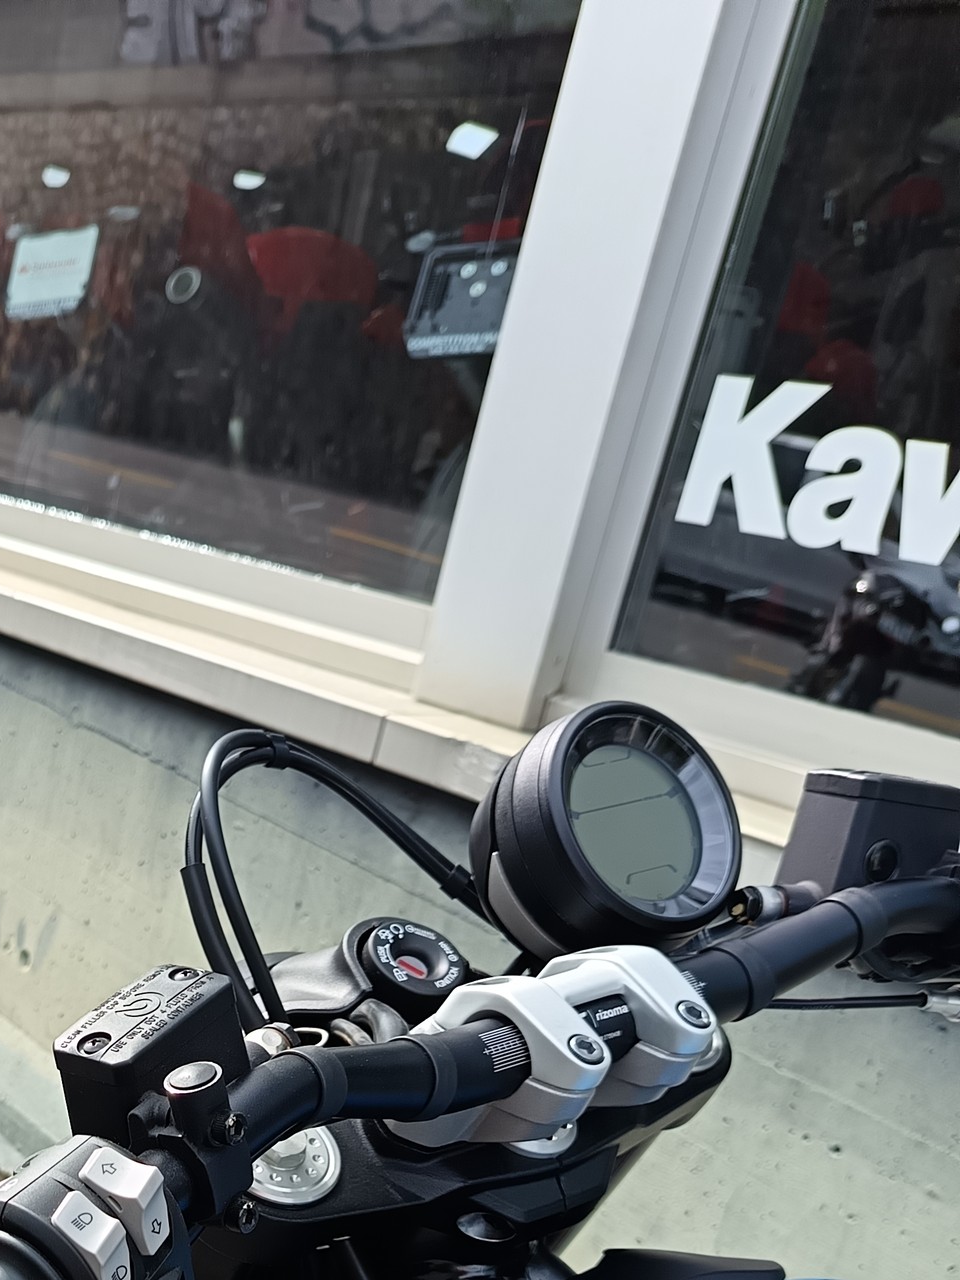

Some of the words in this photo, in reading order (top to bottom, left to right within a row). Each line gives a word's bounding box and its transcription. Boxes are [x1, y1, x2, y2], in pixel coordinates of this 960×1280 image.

[376, 945, 389, 964] PUSH
[434, 966, 460, 989] IGNITION
[60, 1029, 81, 1049] CLEAN
[81, 1009, 108, 1030] FILLER
[107, 1000, 120, 1011] CAP
[110, 1040, 128, 1053] USE
[125, 1025, 145, 1040] ONLY
[145, 1013, 160, 1028] DOT
[165, 993, 188, 1010] FLUID
[140, 1020, 168, 1040] SEALED
[167, 992, 205, 1020] CONTAINER
[595, 1004, 629, 1021] rizoma
